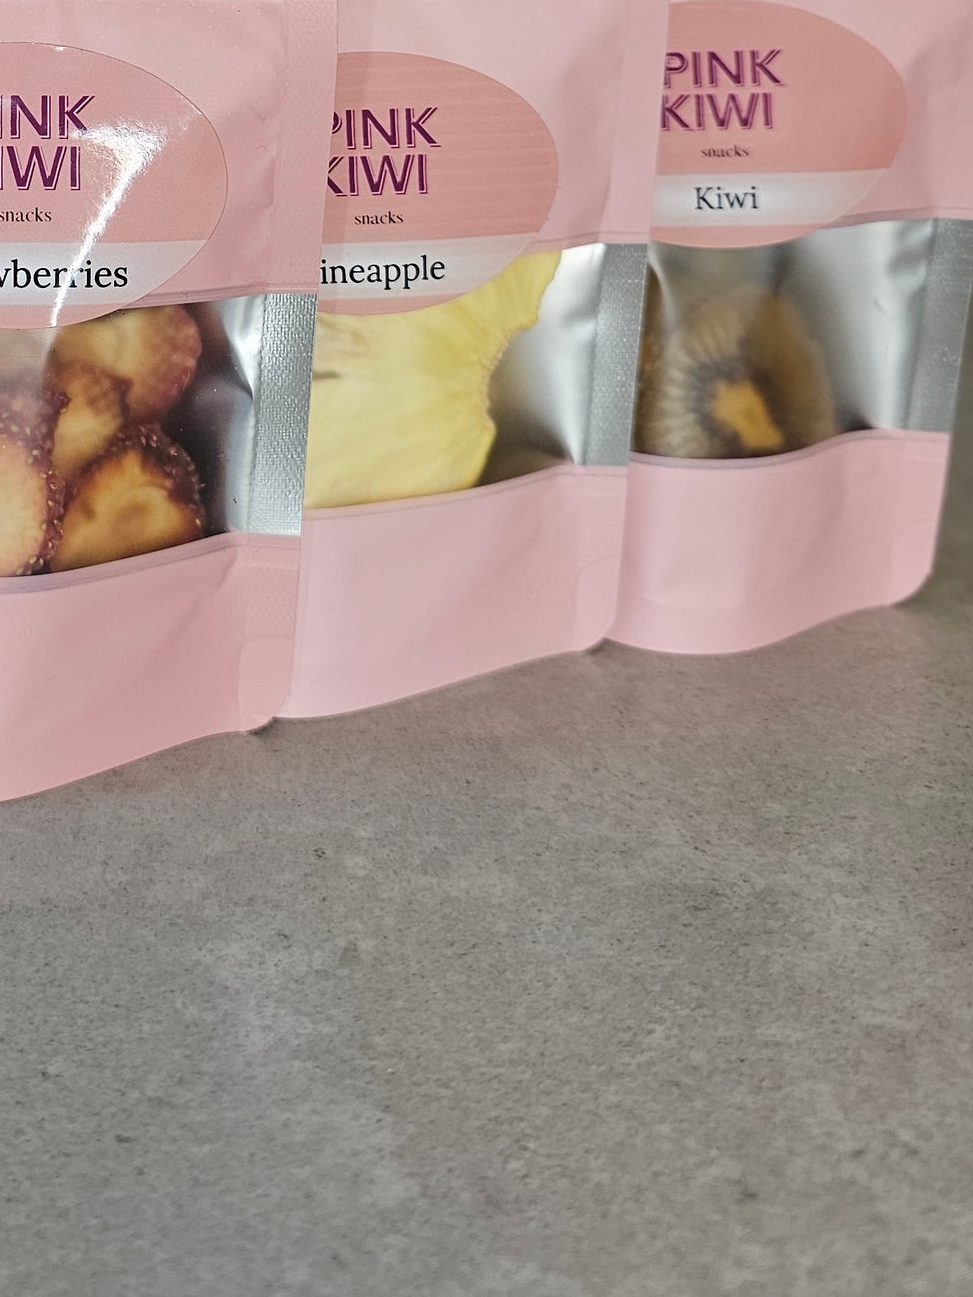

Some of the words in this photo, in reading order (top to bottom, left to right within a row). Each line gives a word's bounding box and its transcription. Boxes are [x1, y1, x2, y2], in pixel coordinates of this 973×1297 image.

[663, 48, 786, 89] PINK
[660, 91, 774, 132] KIWI
[700, 144, 751, 158] snacks
[694, 185, 759, 210] Kiwi
[354, 210, 405, 226] snacks
[319, 254, 446, 291] ineapple
